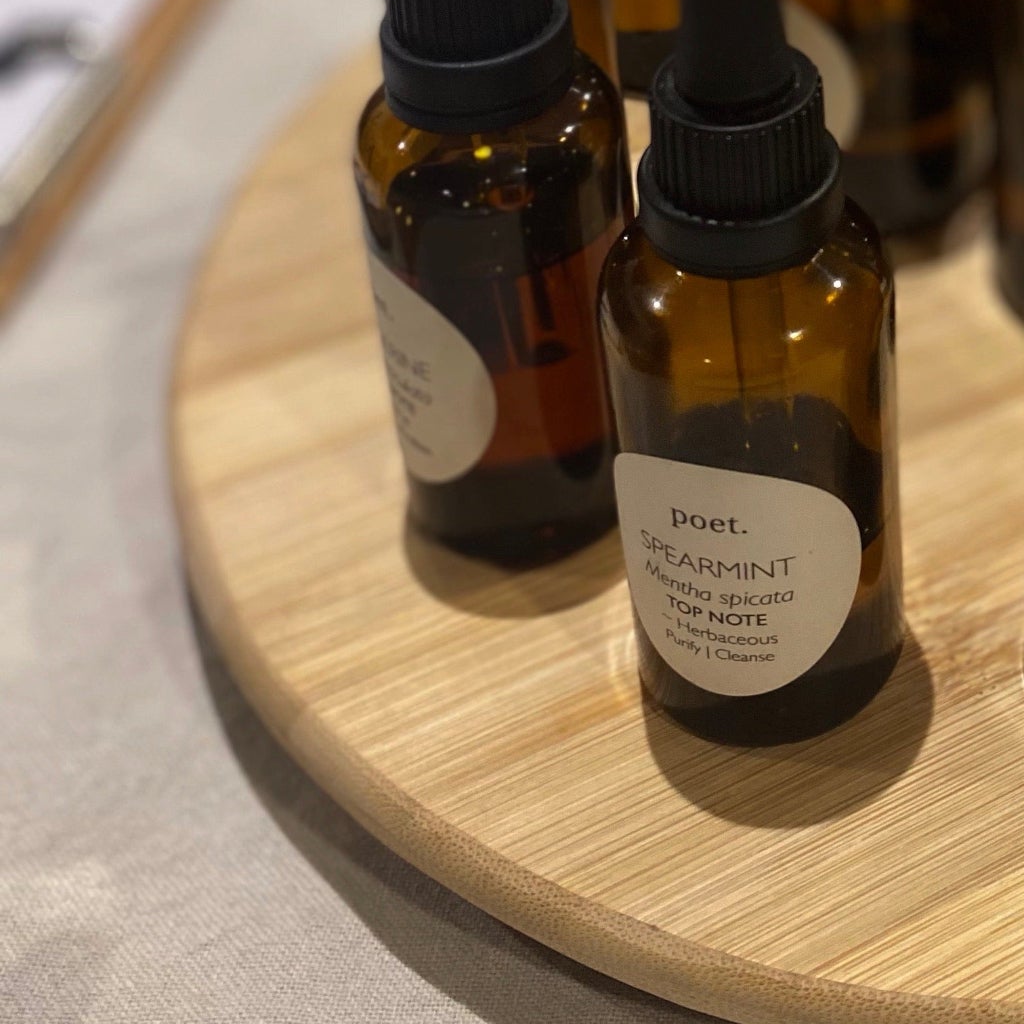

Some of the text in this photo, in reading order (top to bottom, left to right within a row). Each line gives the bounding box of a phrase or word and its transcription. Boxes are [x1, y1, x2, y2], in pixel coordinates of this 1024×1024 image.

[670, 507, 748, 534] poet.
[640, 529, 797, 580] SPEARMINT
[645, 560, 794, 609] Mentha spicata
[666, 594, 768, 626] TOP NOTE
[666, 628, 701, 656] Purify
[715, 648, 776, 663] Cleanse
[676, 618, 779, 646] Herbaceous
